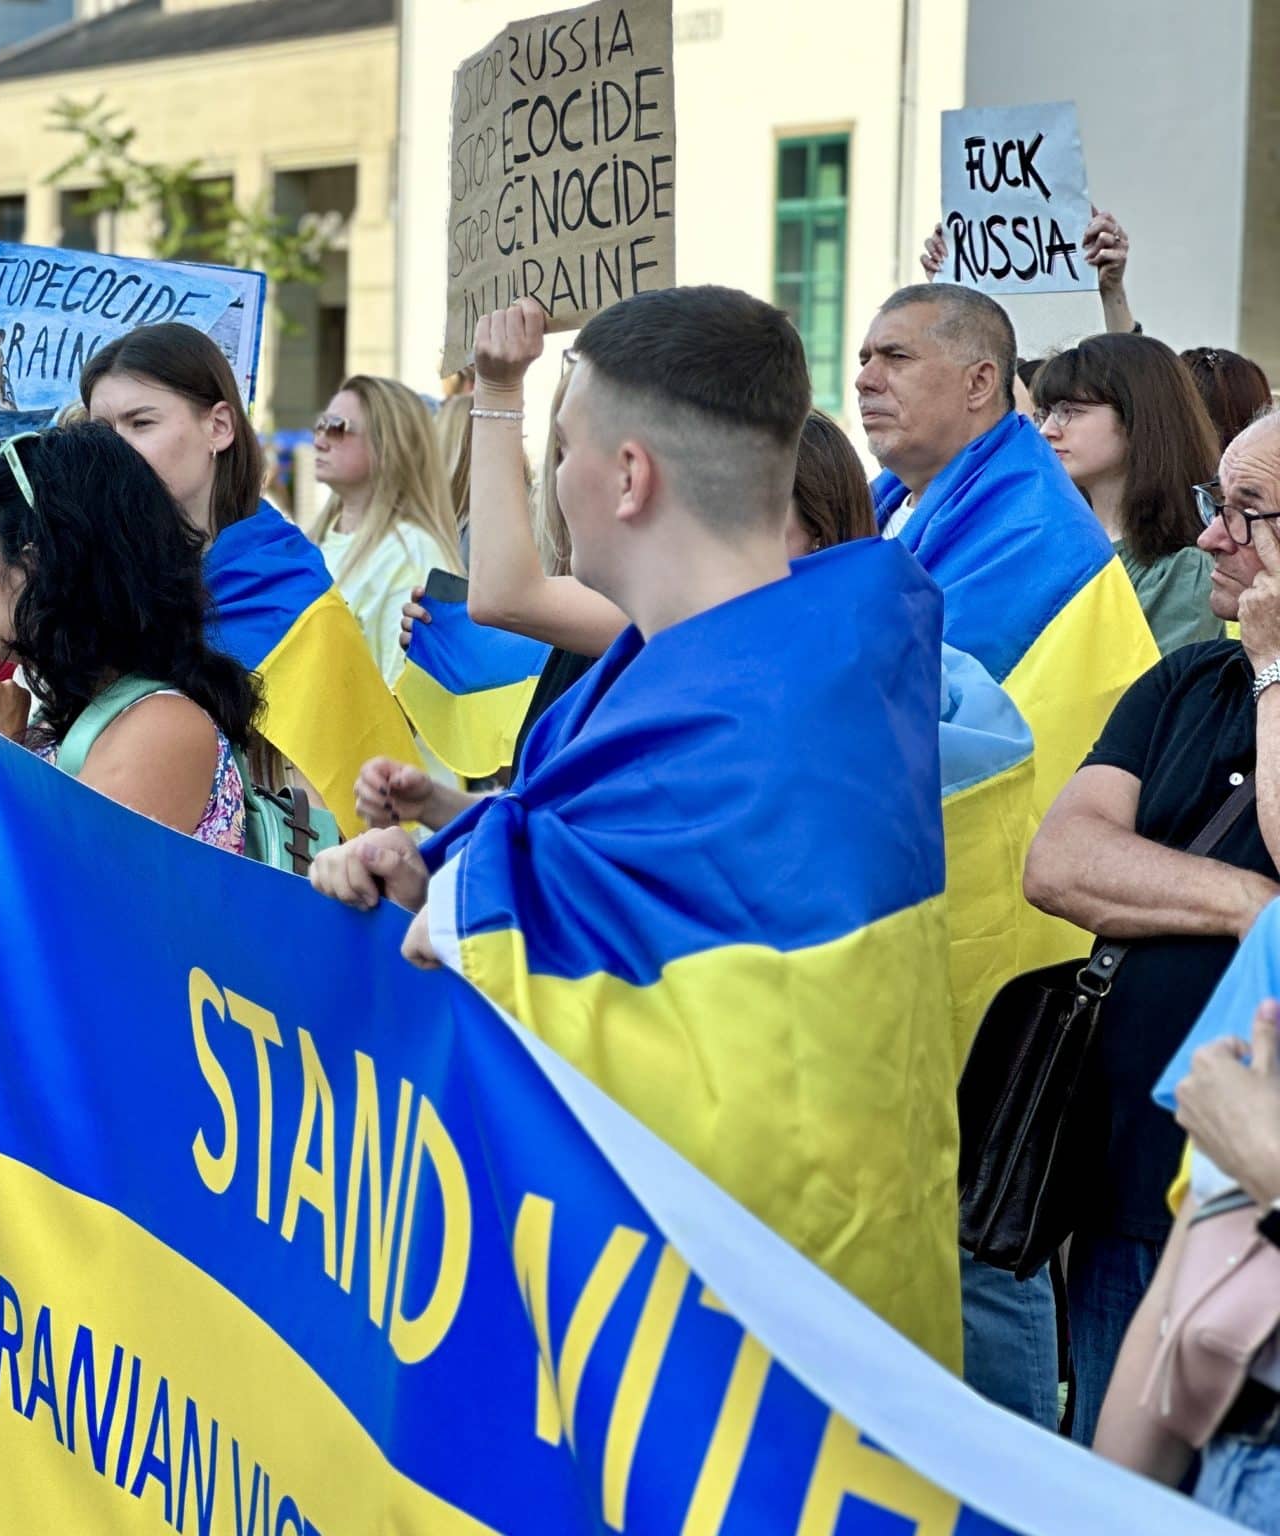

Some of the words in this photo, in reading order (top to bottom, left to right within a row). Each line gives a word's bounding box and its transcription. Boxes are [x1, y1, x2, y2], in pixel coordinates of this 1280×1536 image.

[461, 50, 503, 123] STOP
[509, 9, 634, 86] RUSSIA
[454, 127, 497, 201] STOP
[964, 131, 1052, 202] FUCK
[451, 210, 490, 278] STOP
[947, 211, 1079, 283] RUSSIA
[188, 966, 473, 1365] STAND
